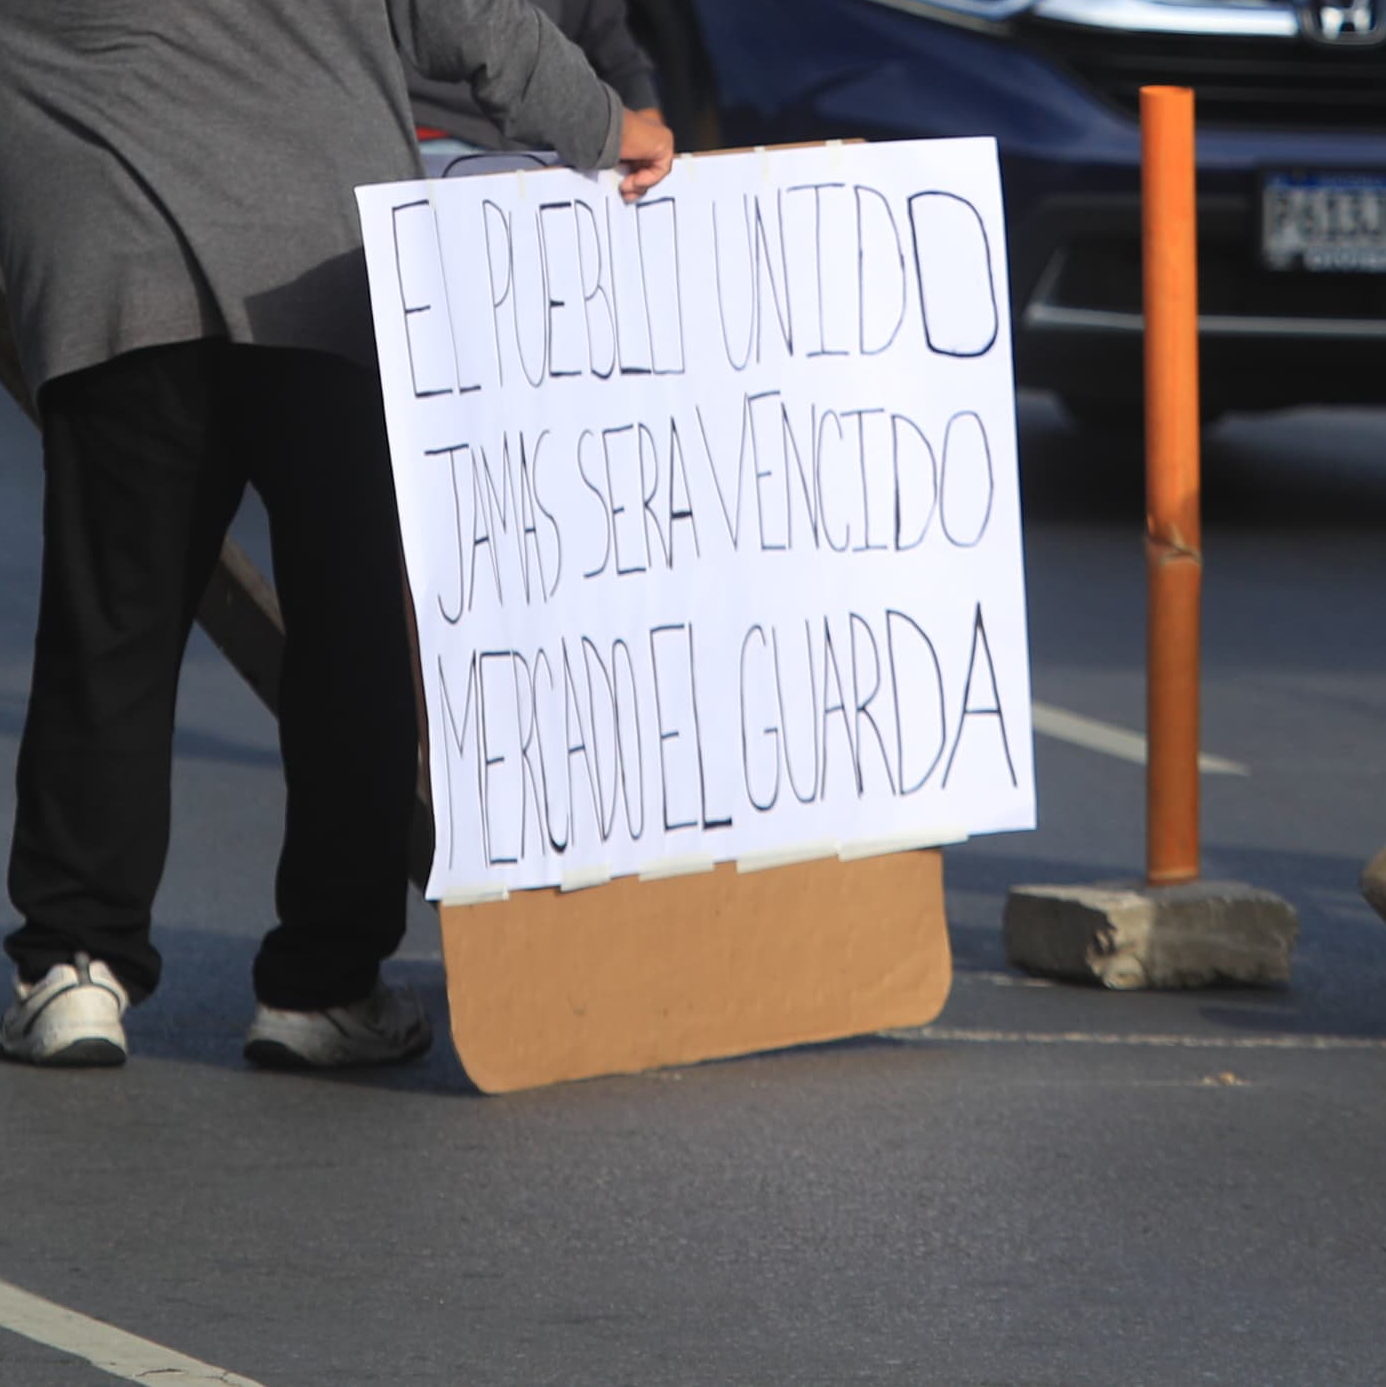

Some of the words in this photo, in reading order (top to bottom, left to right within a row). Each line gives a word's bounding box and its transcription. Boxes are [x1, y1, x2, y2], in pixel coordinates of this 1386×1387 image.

[391, 199, 482, 397] EL
[482, 195, 687, 388] PUEBLO
[712, 182, 999, 372] UNIDO
[424, 429, 562, 625] JAMAS
[576, 416, 701, 579] SERA
[695, 389, 995, 553] VENCIDO
[437, 634, 642, 870] MERCADO
[649, 621, 733, 832] EL
[739, 601, 1019, 813] GUARDA
